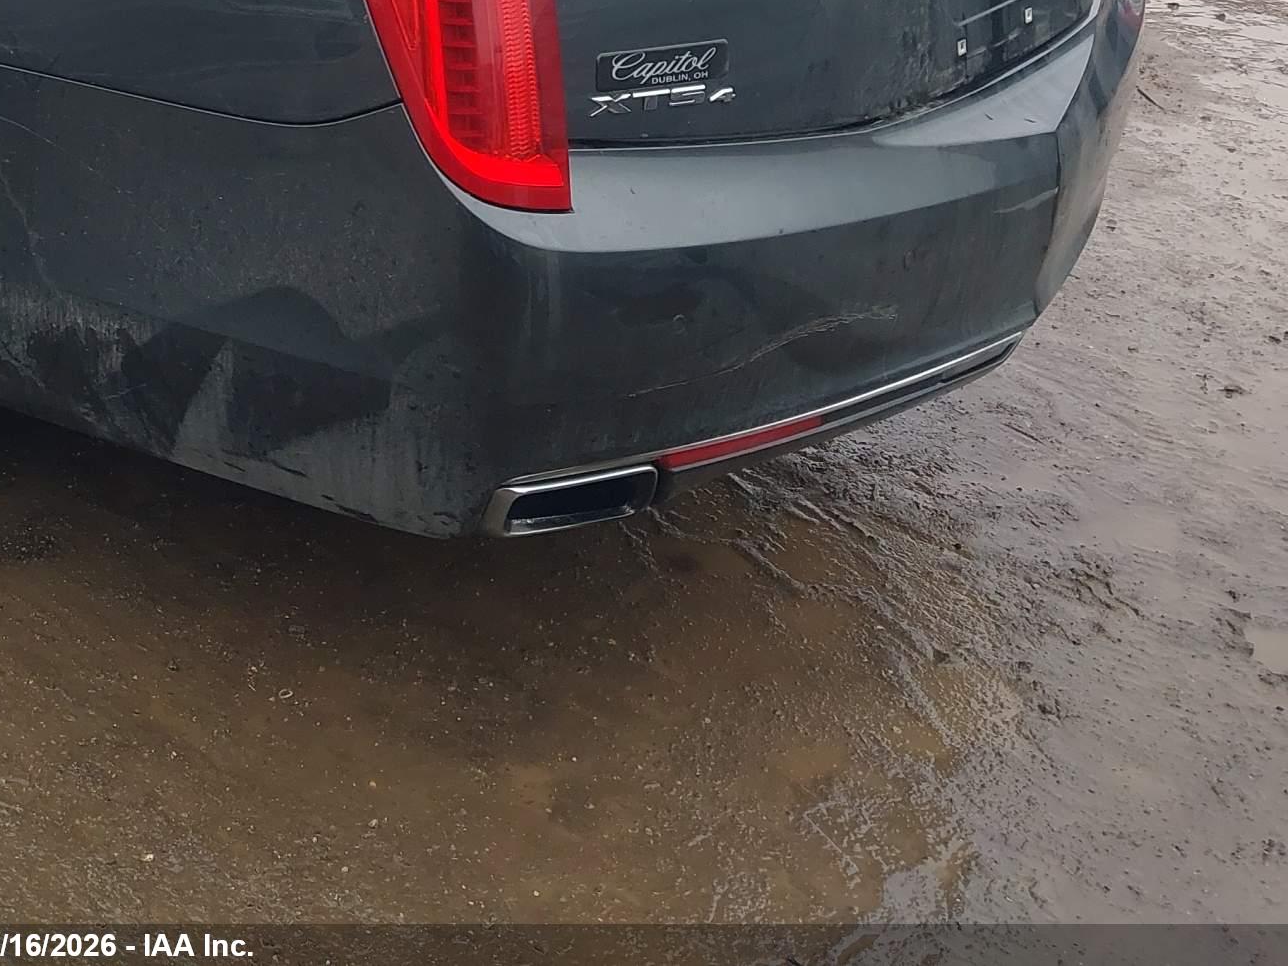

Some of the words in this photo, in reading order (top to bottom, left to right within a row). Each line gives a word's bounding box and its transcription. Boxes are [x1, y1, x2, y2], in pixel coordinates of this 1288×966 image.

[612, 46, 717, 85] Capitol
[651, 73, 692, 85] DUBLIN,
[693, 70, 709, 80] OH
